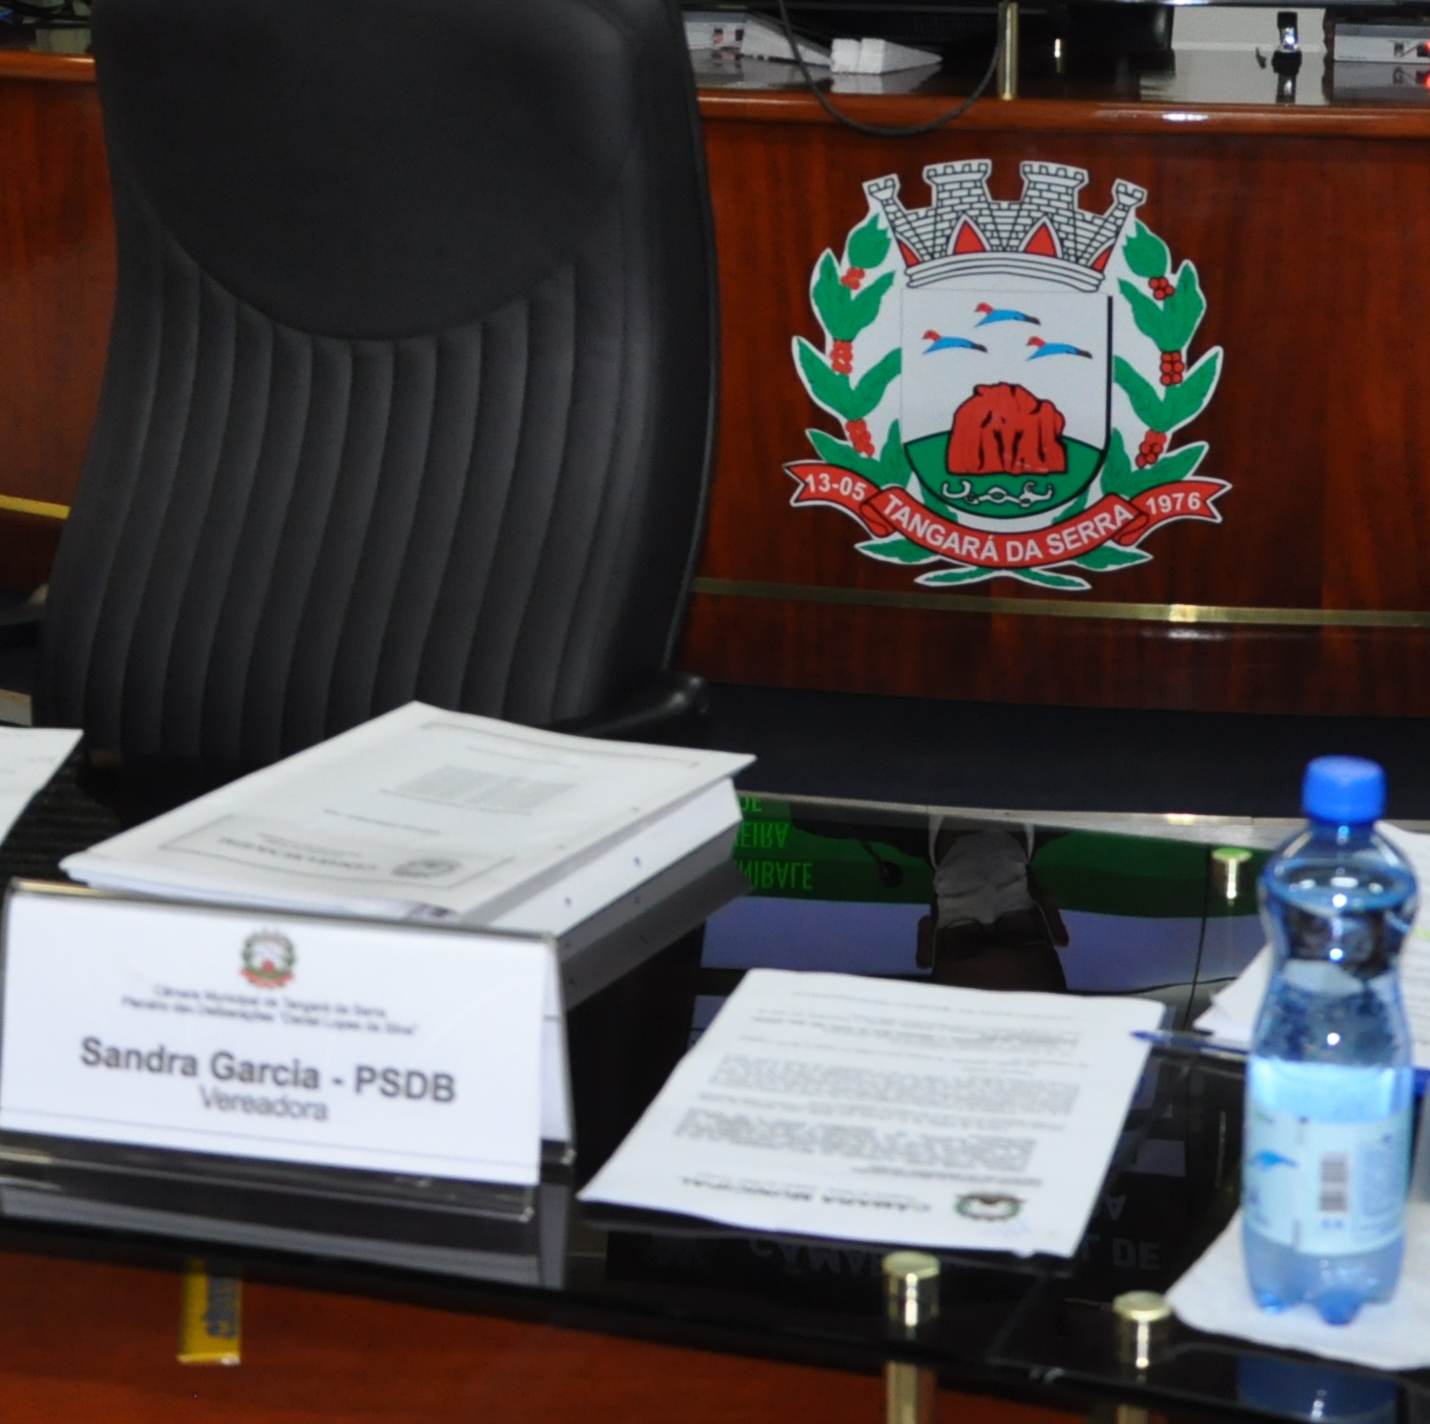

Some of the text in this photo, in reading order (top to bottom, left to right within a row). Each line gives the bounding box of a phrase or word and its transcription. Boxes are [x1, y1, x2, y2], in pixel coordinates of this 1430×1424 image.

[804, 473, 867, 502] 13-05
[1146, 492, 1201, 516] 1976
[884, 493, 1135, 563] TANGARÁ DA SERRA
[81, 1036, 198, 1078] Sandra
[210, 1051, 321, 1090] Garcia
[354, 1065, 456, 1104] PSDB
[199, 1085, 329, 1122] Vereadora
